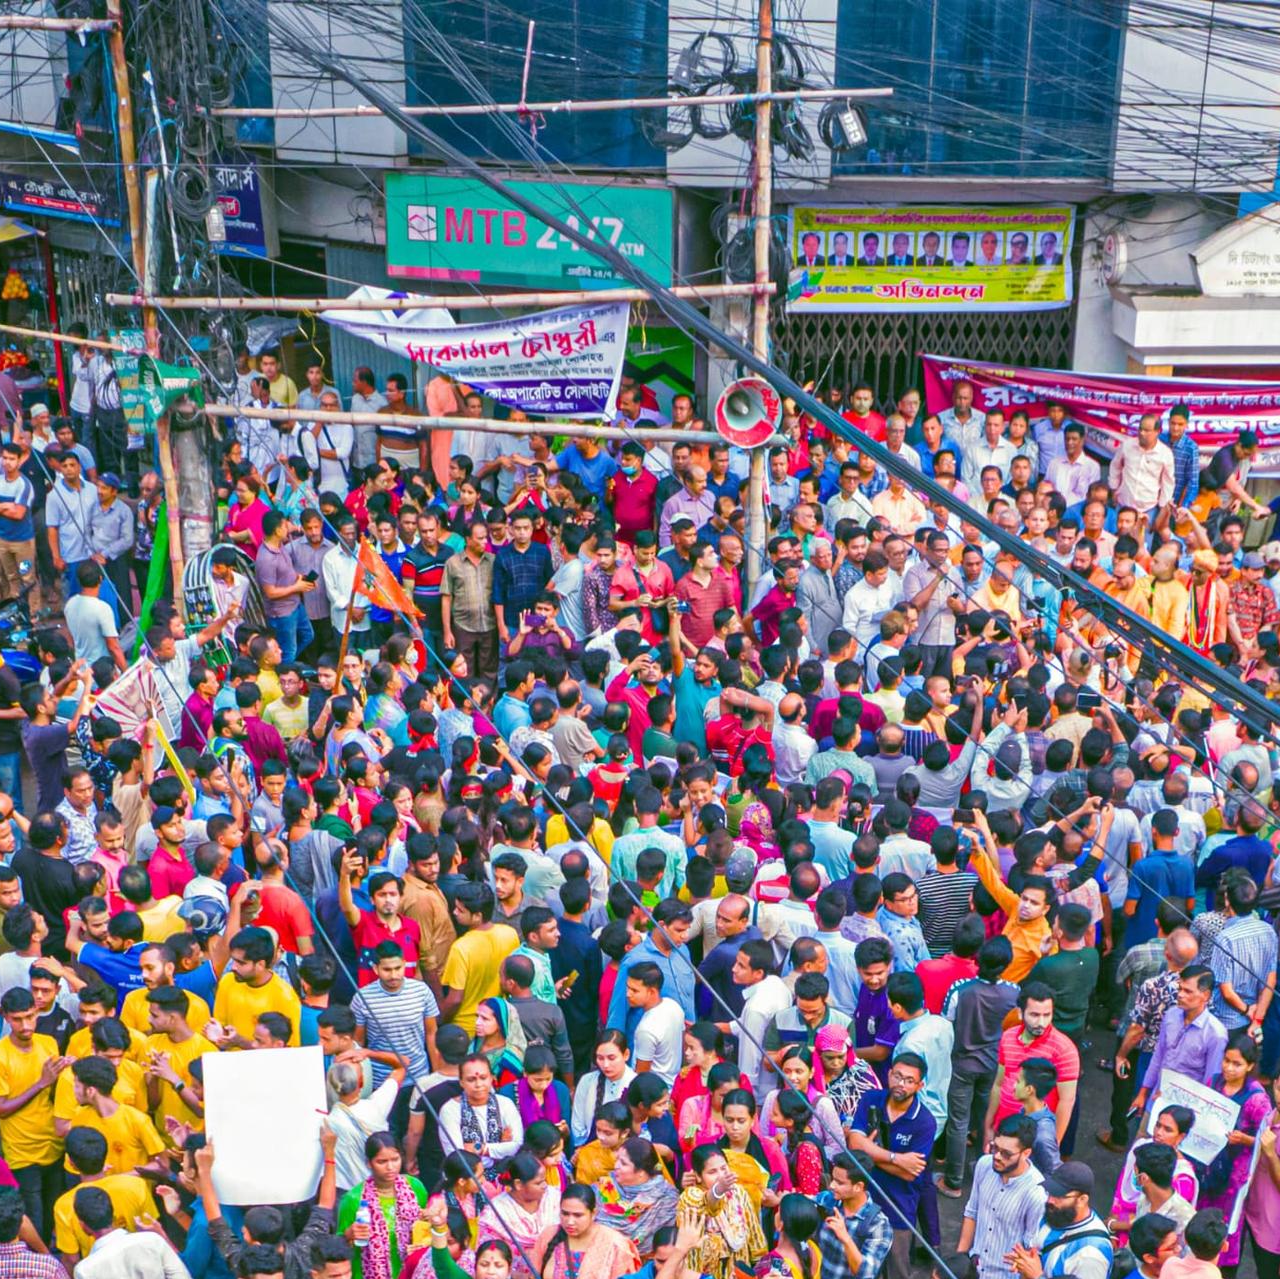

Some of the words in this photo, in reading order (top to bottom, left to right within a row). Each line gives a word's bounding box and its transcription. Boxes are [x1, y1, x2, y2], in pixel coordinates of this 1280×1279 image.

[445, 207, 528, 246] MTB
[620, 243, 644, 256] ATM
[876, 279, 986, 301] অভিনন্দন
